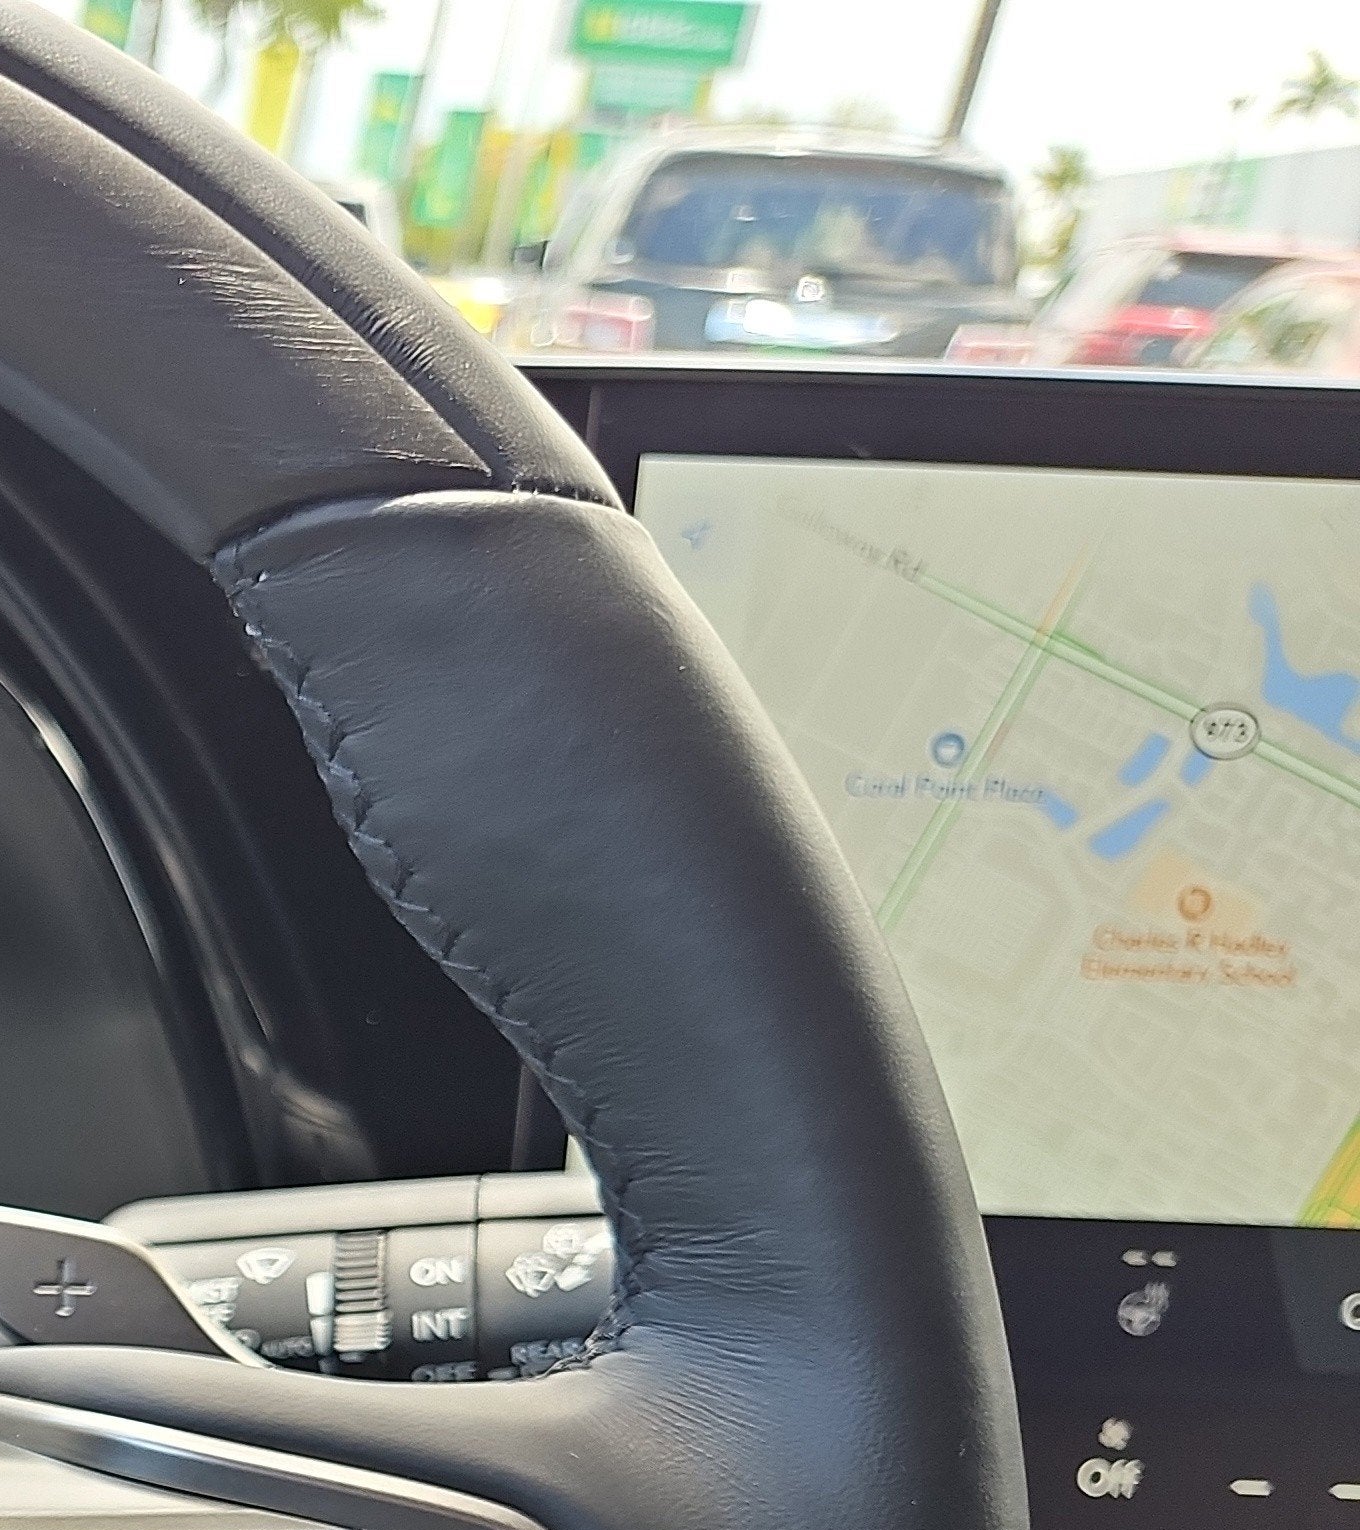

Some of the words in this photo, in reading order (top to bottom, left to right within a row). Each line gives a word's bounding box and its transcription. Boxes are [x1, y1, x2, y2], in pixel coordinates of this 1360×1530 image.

[409, 1255, 467, 1287] ON
[411, 1307, 472, 1342] INT
[1077, 1457, 1144, 1499] OFF
